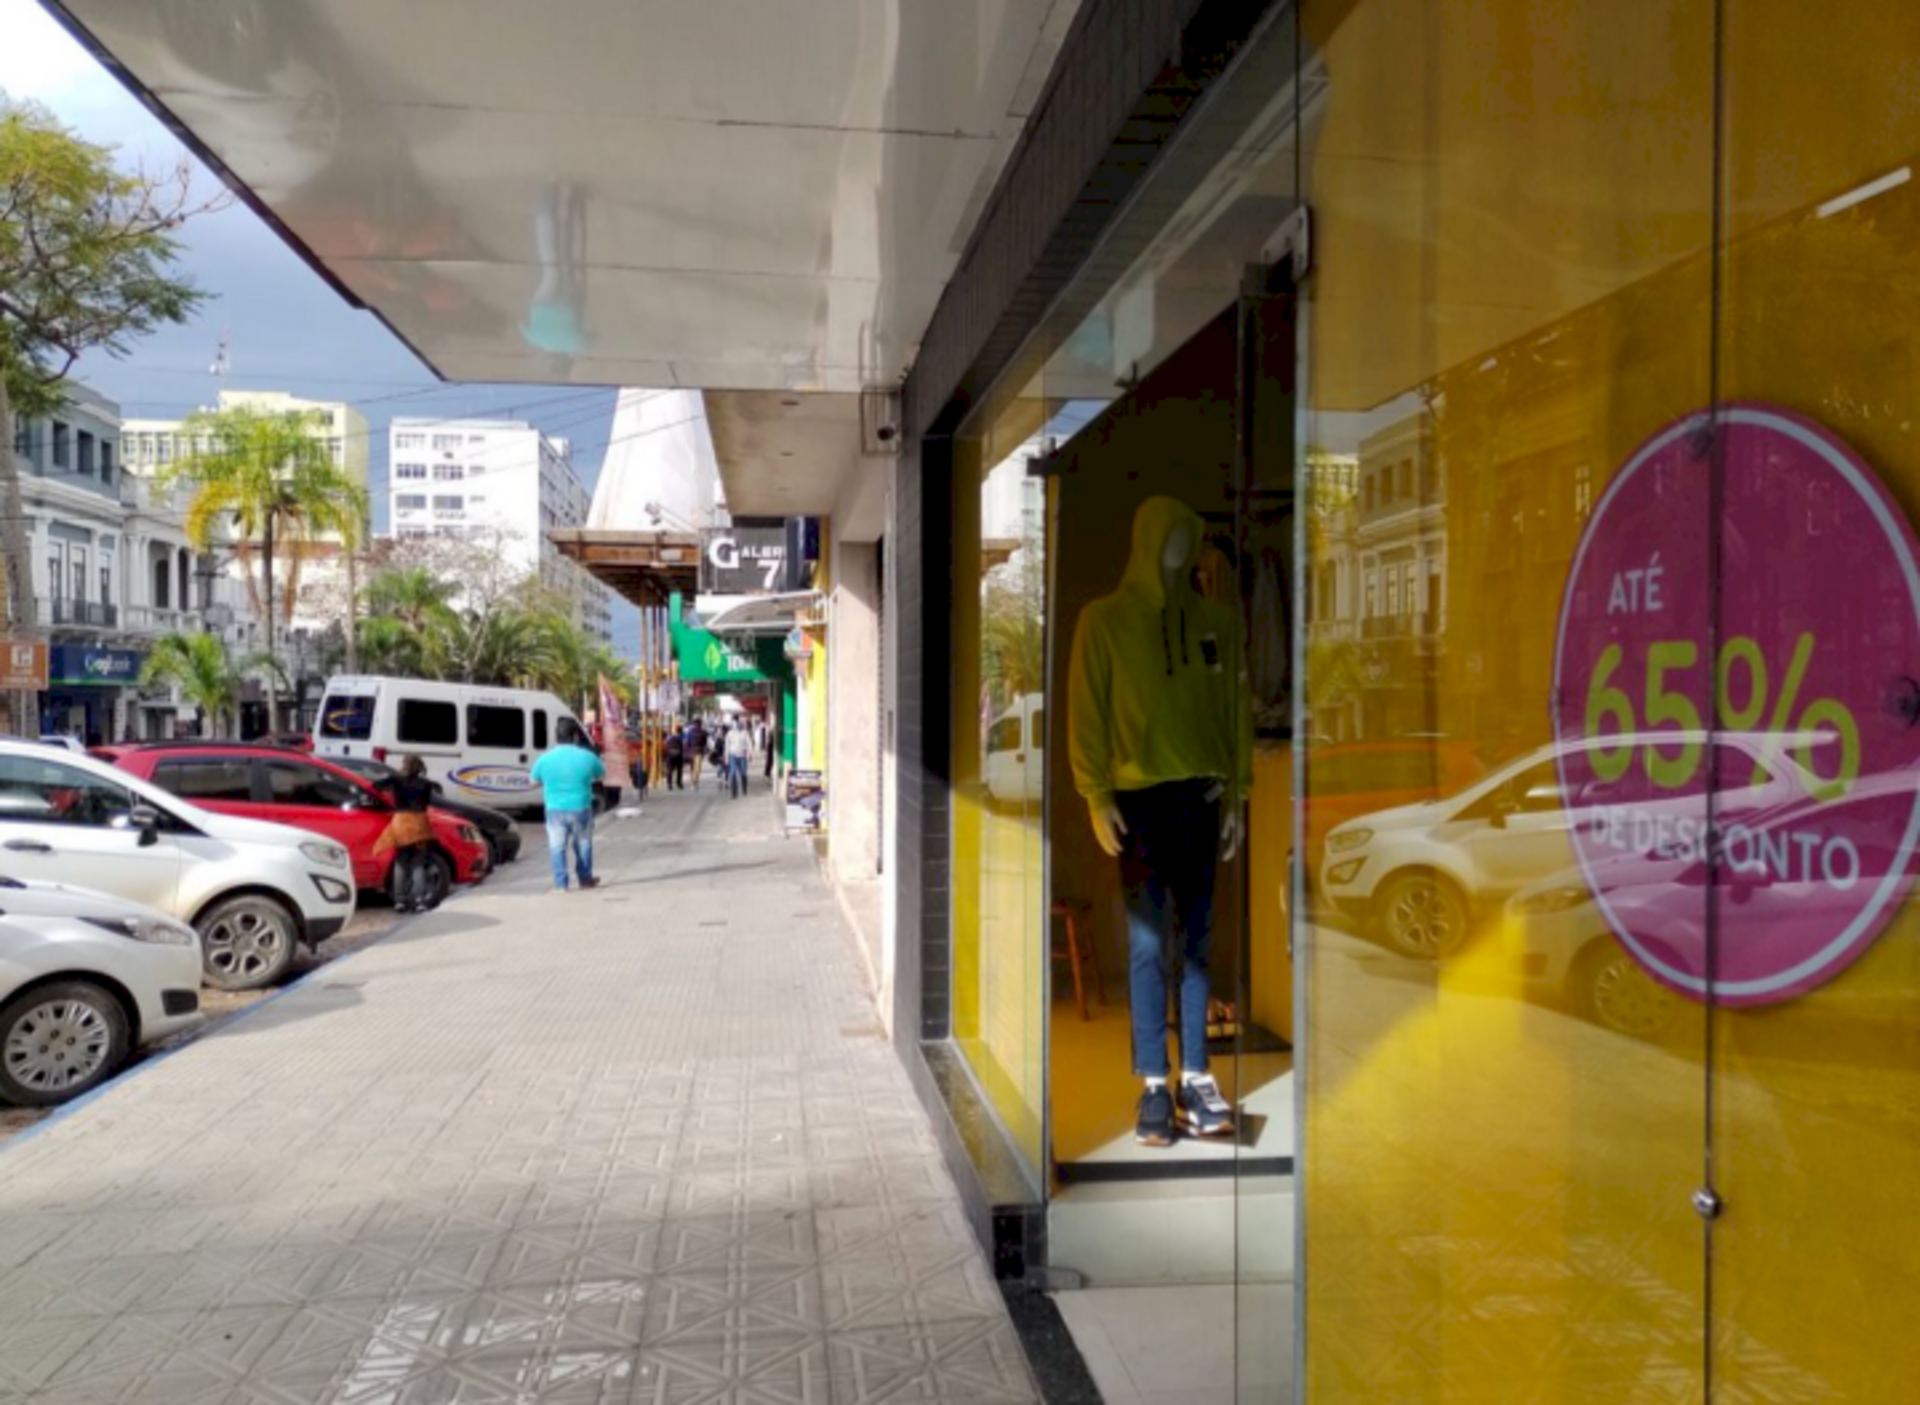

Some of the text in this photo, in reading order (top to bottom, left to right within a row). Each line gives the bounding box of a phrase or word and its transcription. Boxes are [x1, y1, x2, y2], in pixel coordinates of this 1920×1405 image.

[709, 537, 784, 569] GALER
[757, 559, 781, 589] 7
[1607, 551, 1664, 615] ATÉ
[1584, 631, 1861, 804] 65%
[1589, 805, 1860, 890] DE DESCONTO
